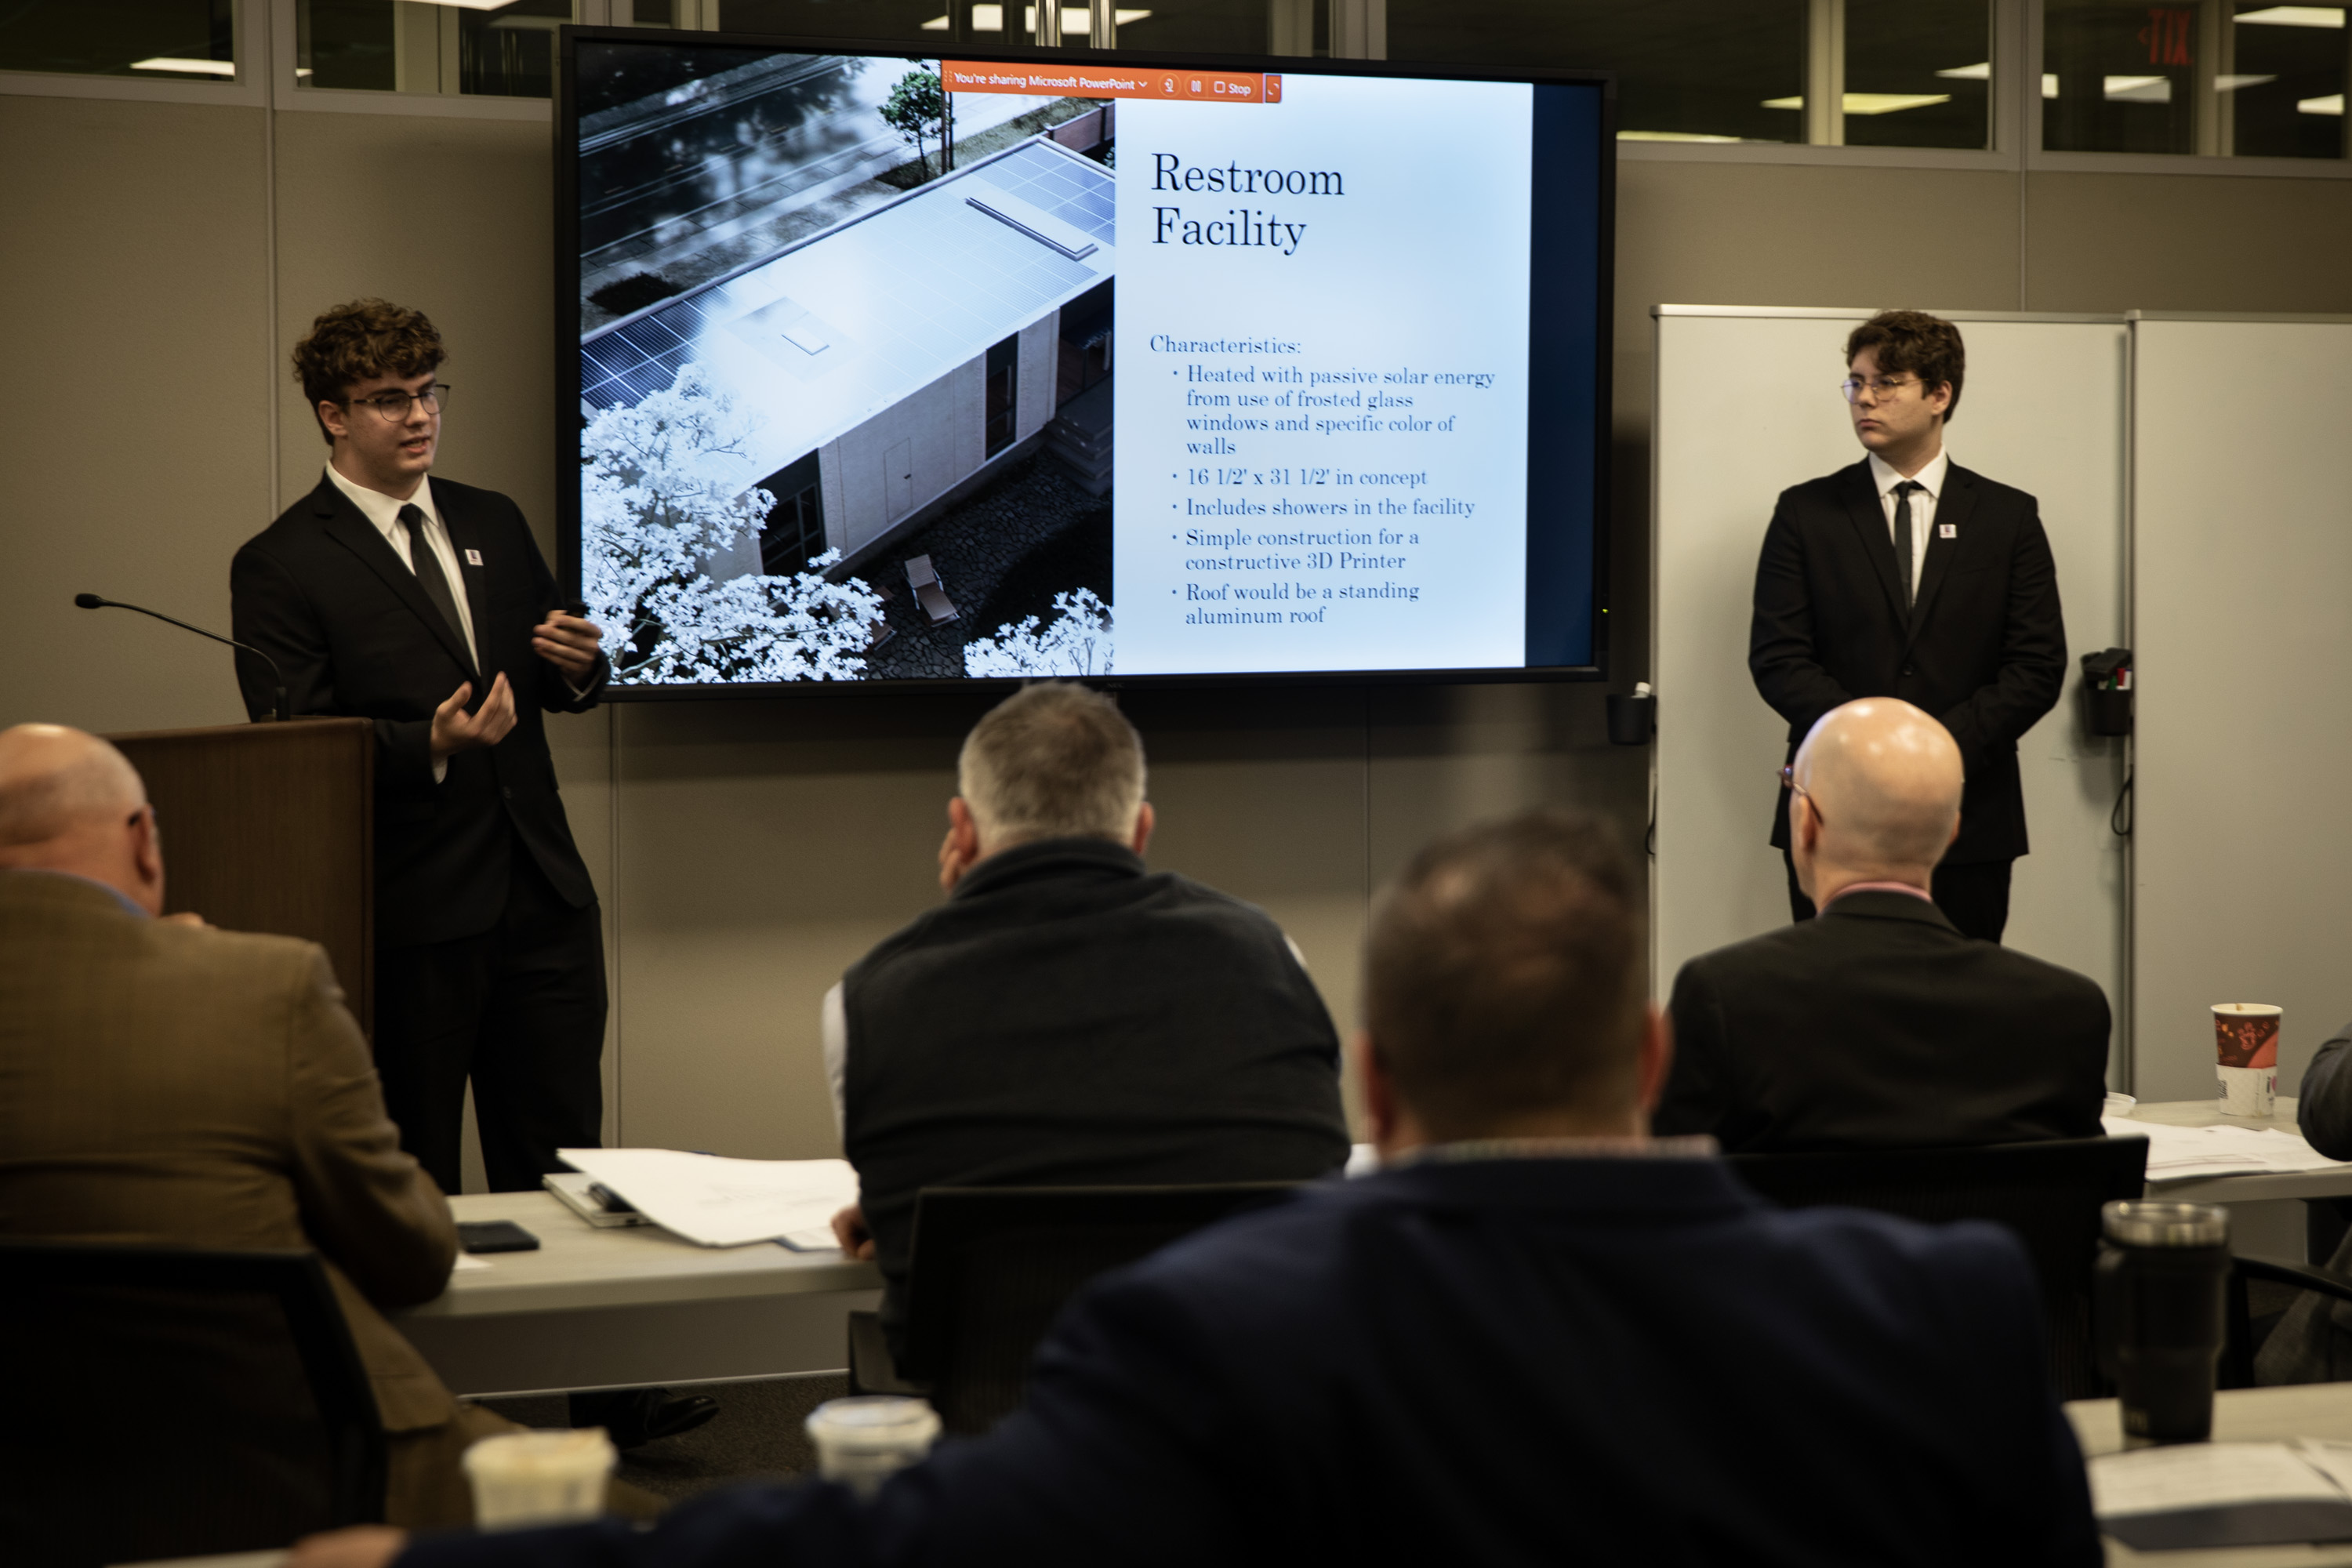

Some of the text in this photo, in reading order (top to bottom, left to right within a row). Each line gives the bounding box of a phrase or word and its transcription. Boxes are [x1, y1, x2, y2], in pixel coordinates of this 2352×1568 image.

[953, 72, 1135, 90] You're sharing Microsoft PowerPoint
[1228, 82, 1251, 96] Stop
[1151, 153, 1345, 196] Restroom
[1152, 206, 1307, 256] Facility
[1150, 335, 1301, 354] Characteristics:
[1188, 365, 1495, 389] Heated with passive solar energy
[1187, 389, 1413, 412] from use of frosted glass
[1186, 413, 1456, 436] windows and specific color of
[1186, 437, 1236, 455] walls
[1189, 468, 1426, 489] 16 1/2' x 31 1/2' in concept
[1187, 497, 1475, 519] Includes showers in the facility
[1186, 528, 1419, 550] Simple construction for a
[1185, 551, 1406, 570] constructive 3D Printer
[1187, 581, 1420, 602] Roof would be a standing
[1185, 605, 1327, 625] aluminum roof
